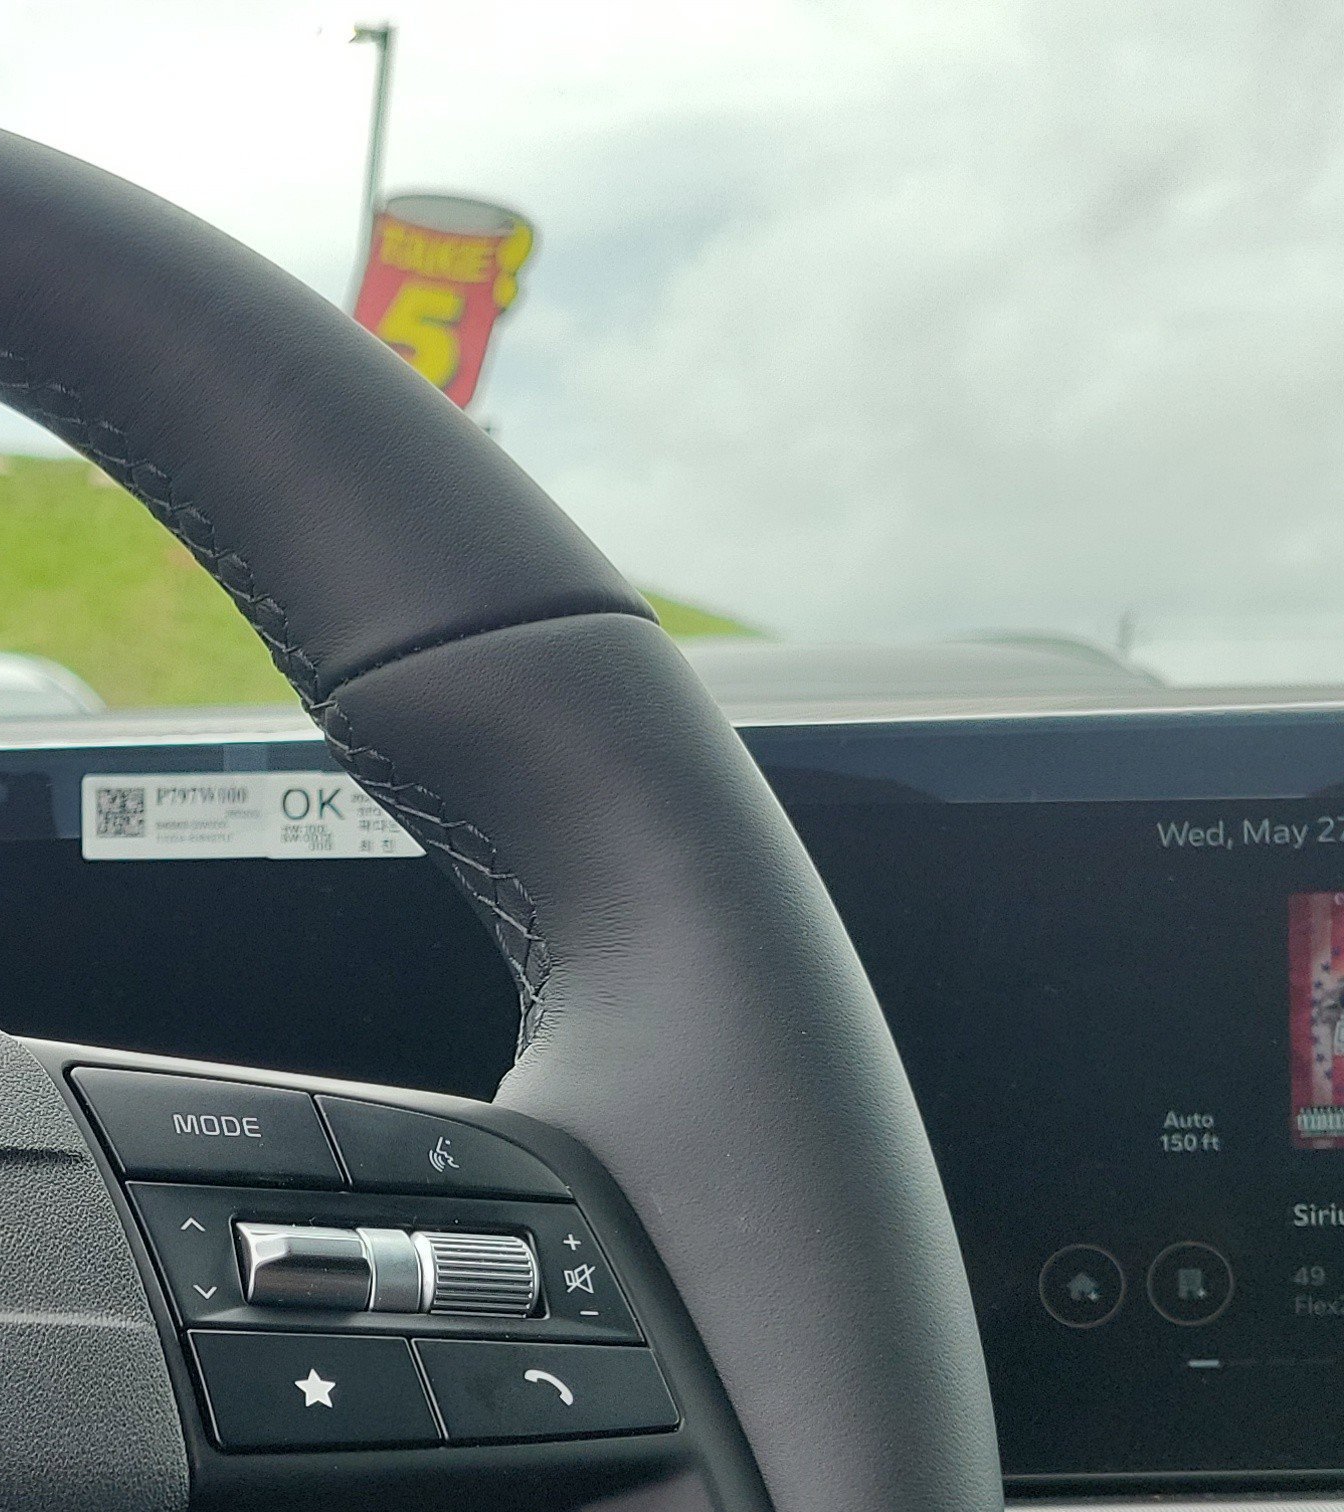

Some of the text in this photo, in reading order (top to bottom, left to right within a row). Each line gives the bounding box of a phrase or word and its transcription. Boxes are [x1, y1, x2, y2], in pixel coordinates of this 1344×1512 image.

[378, 280, 464, 391] 5
[282, 788, 345, 820] OK
[1157, 820, 1234, 850] Wed,
[1242, 817, 1309, 849] May
[172, 1113, 262, 1138] MODE
[1163, 1110, 1214, 1129] Auto
[1161, 1131, 1220, 1151] 150 ft
